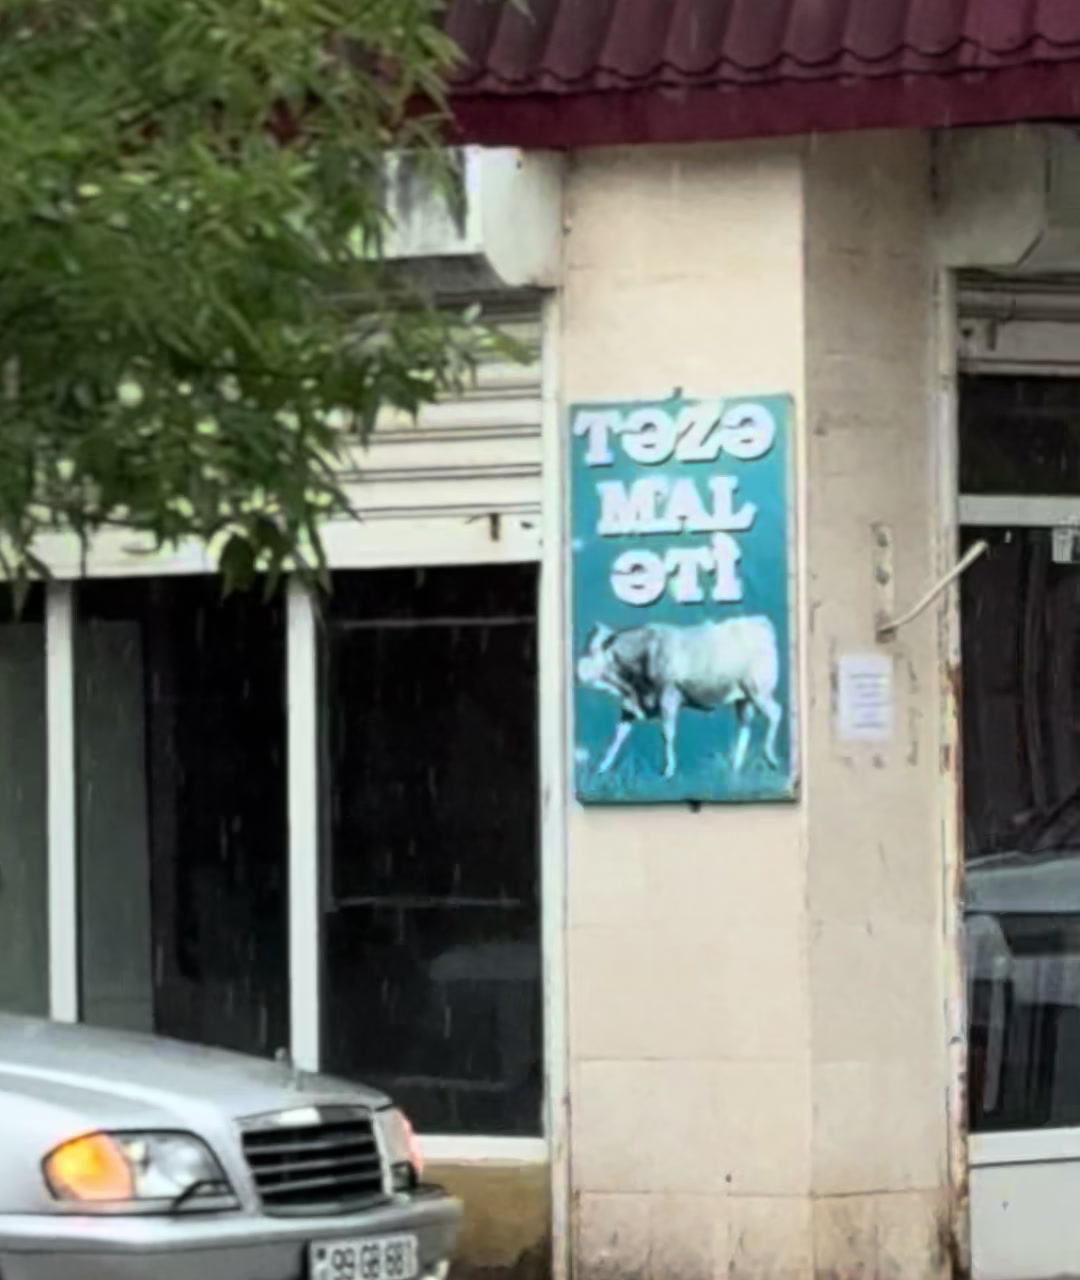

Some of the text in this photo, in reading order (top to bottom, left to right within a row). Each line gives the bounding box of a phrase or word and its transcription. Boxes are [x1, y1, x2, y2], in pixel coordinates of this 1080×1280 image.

[573, 399, 775, 466] TƏZƏ
[595, 475, 757, 537] MAL
[610, 531, 742, 607] ƏTİ
